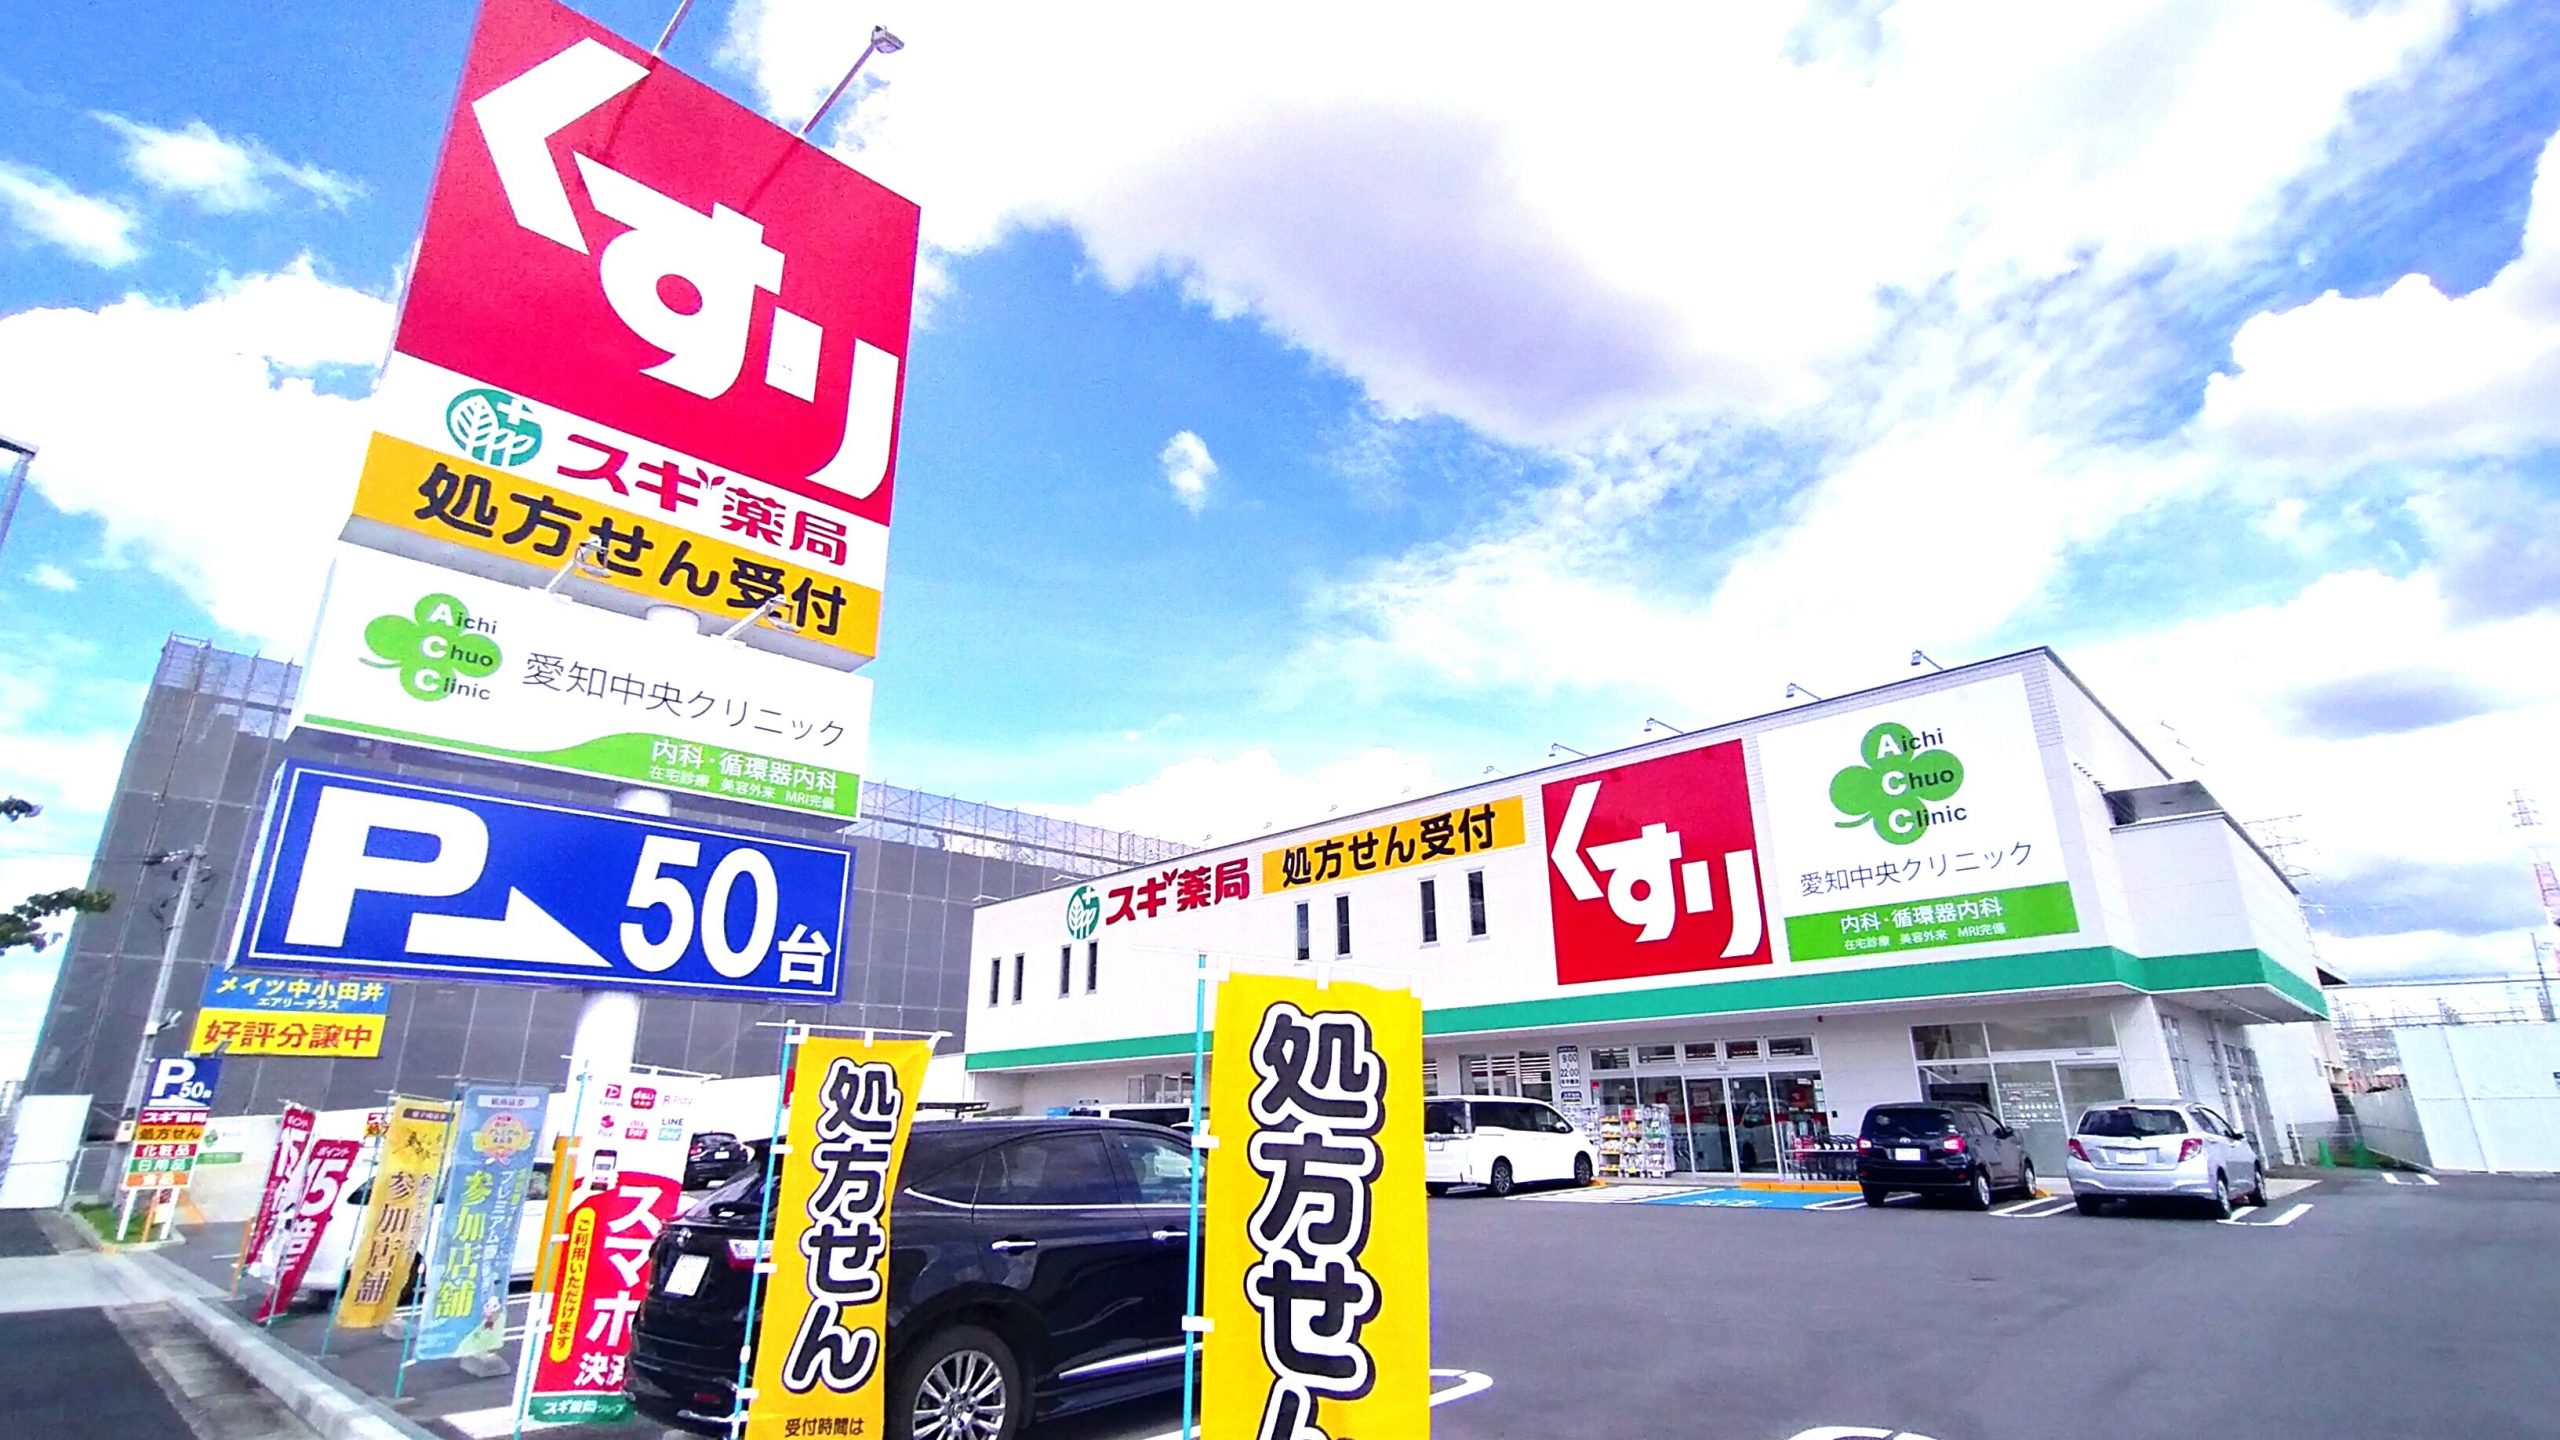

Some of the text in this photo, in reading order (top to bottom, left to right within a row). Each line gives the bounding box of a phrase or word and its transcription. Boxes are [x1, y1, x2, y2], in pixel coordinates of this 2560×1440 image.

[471, 36, 900, 500] くすり
[557, 432, 848, 567] スギ薬局
[413, 460, 847, 637] 処方せん受付
[427, 602, 498, 635] Aichi
[421, 635, 494, 668] Chuo
[413, 666, 491, 701] Clinic
[521, 652, 845, 748] 愛知中央クリニック
[1876, 728, 1944, 760] Aichi
[649, 765, 836, 810] 在宅診療 美容外来 MRI完備
[652, 739, 838, 795] 内科・循環器内科
[1881, 768, 1955, 796] Chuo
[1888, 805, 1968, 834] Clinic
[284, 786, 489, 948] P
[1281, 803, 1496, 889] 処方せん受付
[1550, 780, 1764, 958] くすり
[1800, 841, 2032, 897] 愛知中央クリニック
[1105, 856, 1250, 926] スギ薬局
[1840, 896, 2004, 935] 内科・循環器内科
[1844, 922, 2007, 951] 在宅診療 美容外来 MRI完備
[216, 976, 385, 1002] メイツ中小田井
[257, 997, 340, 1010] エアリーテラス
[204, 1020, 372, 1050] 好評分譲中
[151, 1059, 196, 1098] P
[1560, 1069, 1579, 1078] 22:00
[661, 1118, 684, 1126] LINE
[316, 1146, 350, 1158] ポイント
[355, 1170, 416, 1306] 参加店舗
[435, 1169, 493, 1319] 参加店舗
[782, 1057, 900, 1393] 処方せん
[556, 1219, 591, 1350] ご利用いただけます
[585, 1185, 664, 1347] スマホ
[784, 1416, 865, 1440] 受付時間は
